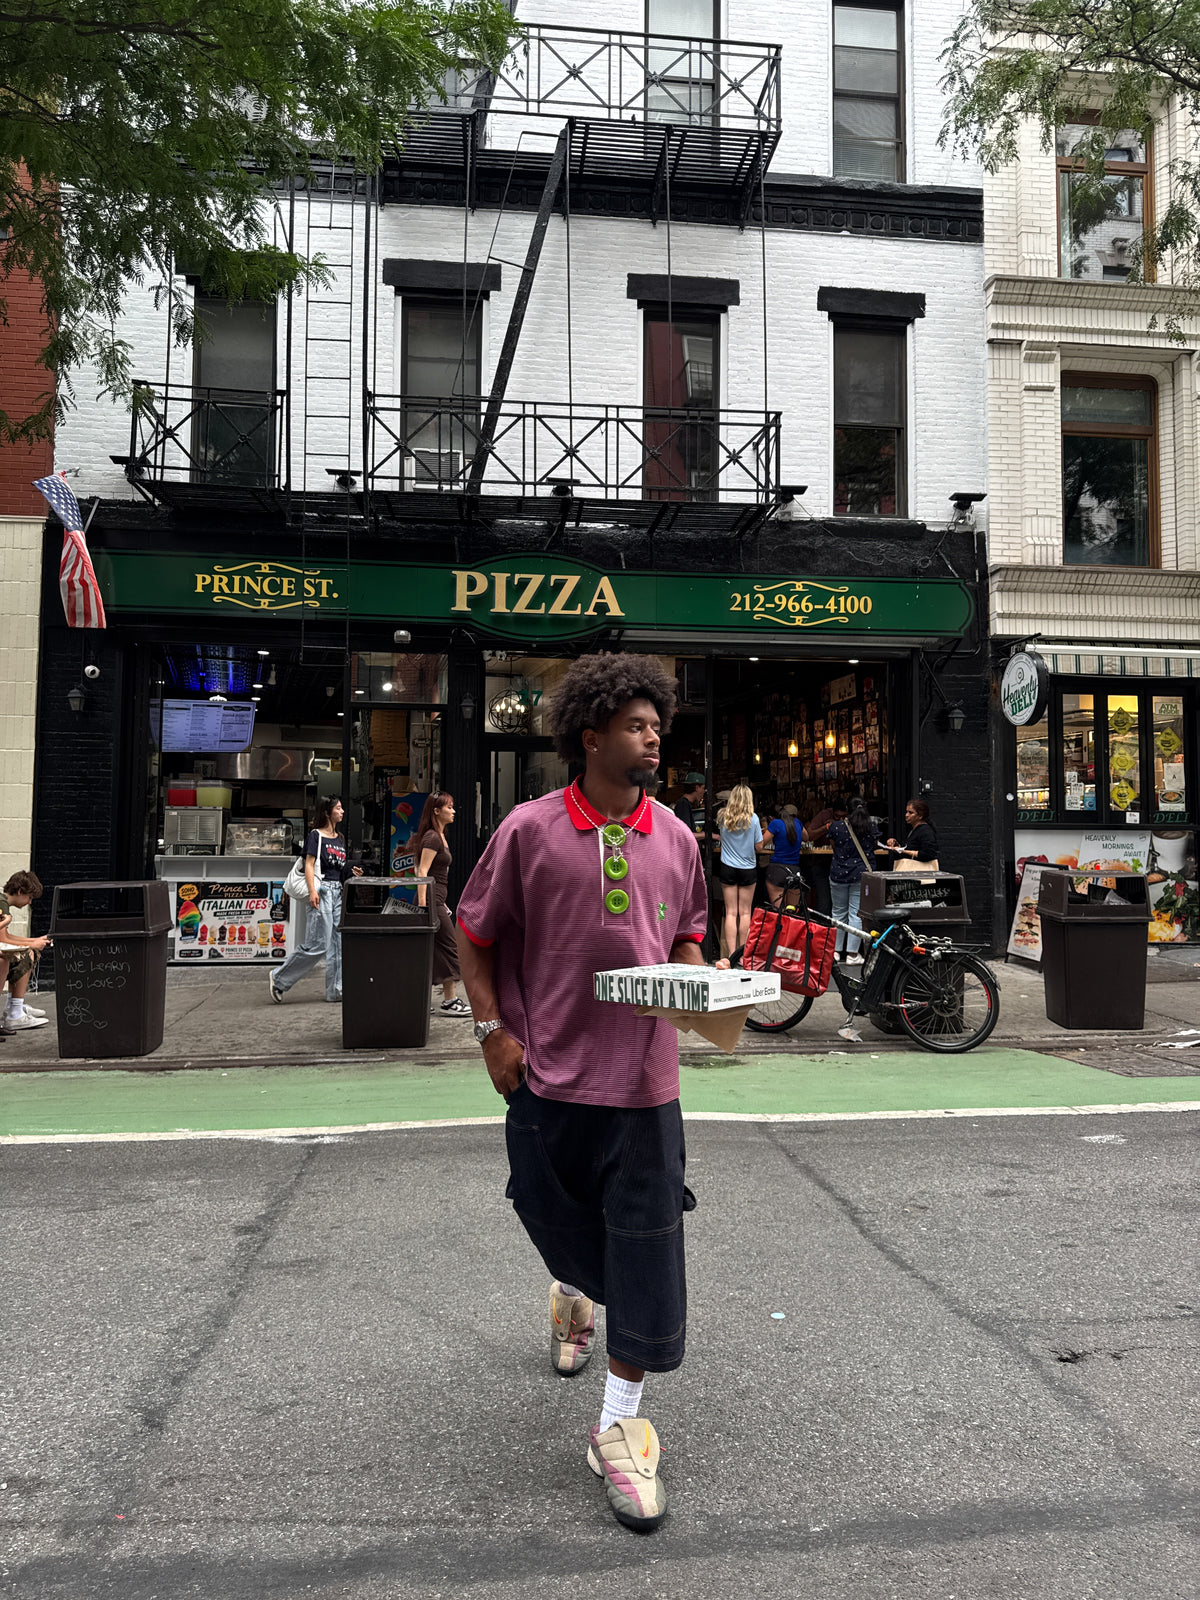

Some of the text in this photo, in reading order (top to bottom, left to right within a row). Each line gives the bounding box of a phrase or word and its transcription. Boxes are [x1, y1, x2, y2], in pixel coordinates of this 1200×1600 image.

[194, 573, 339, 598] PRINCE ST.
[450, 570, 625, 616] PIZZA
[729, 592, 873, 614] 212-966-4100
[1003, 674, 1037, 708] Heavenly
[1011, 692, 1033, 716] DELI
[1017, 811, 1055, 822] DELI
[1153, 812, 1190, 823] DELI
[209, 883, 258, 894] Prince St.
[201, 899, 268, 911] ITALIAN ICES
[595, 973, 709, 1012] ONE SLICE AT A TIME
[752, 986, 776, 998] Uber Eats
